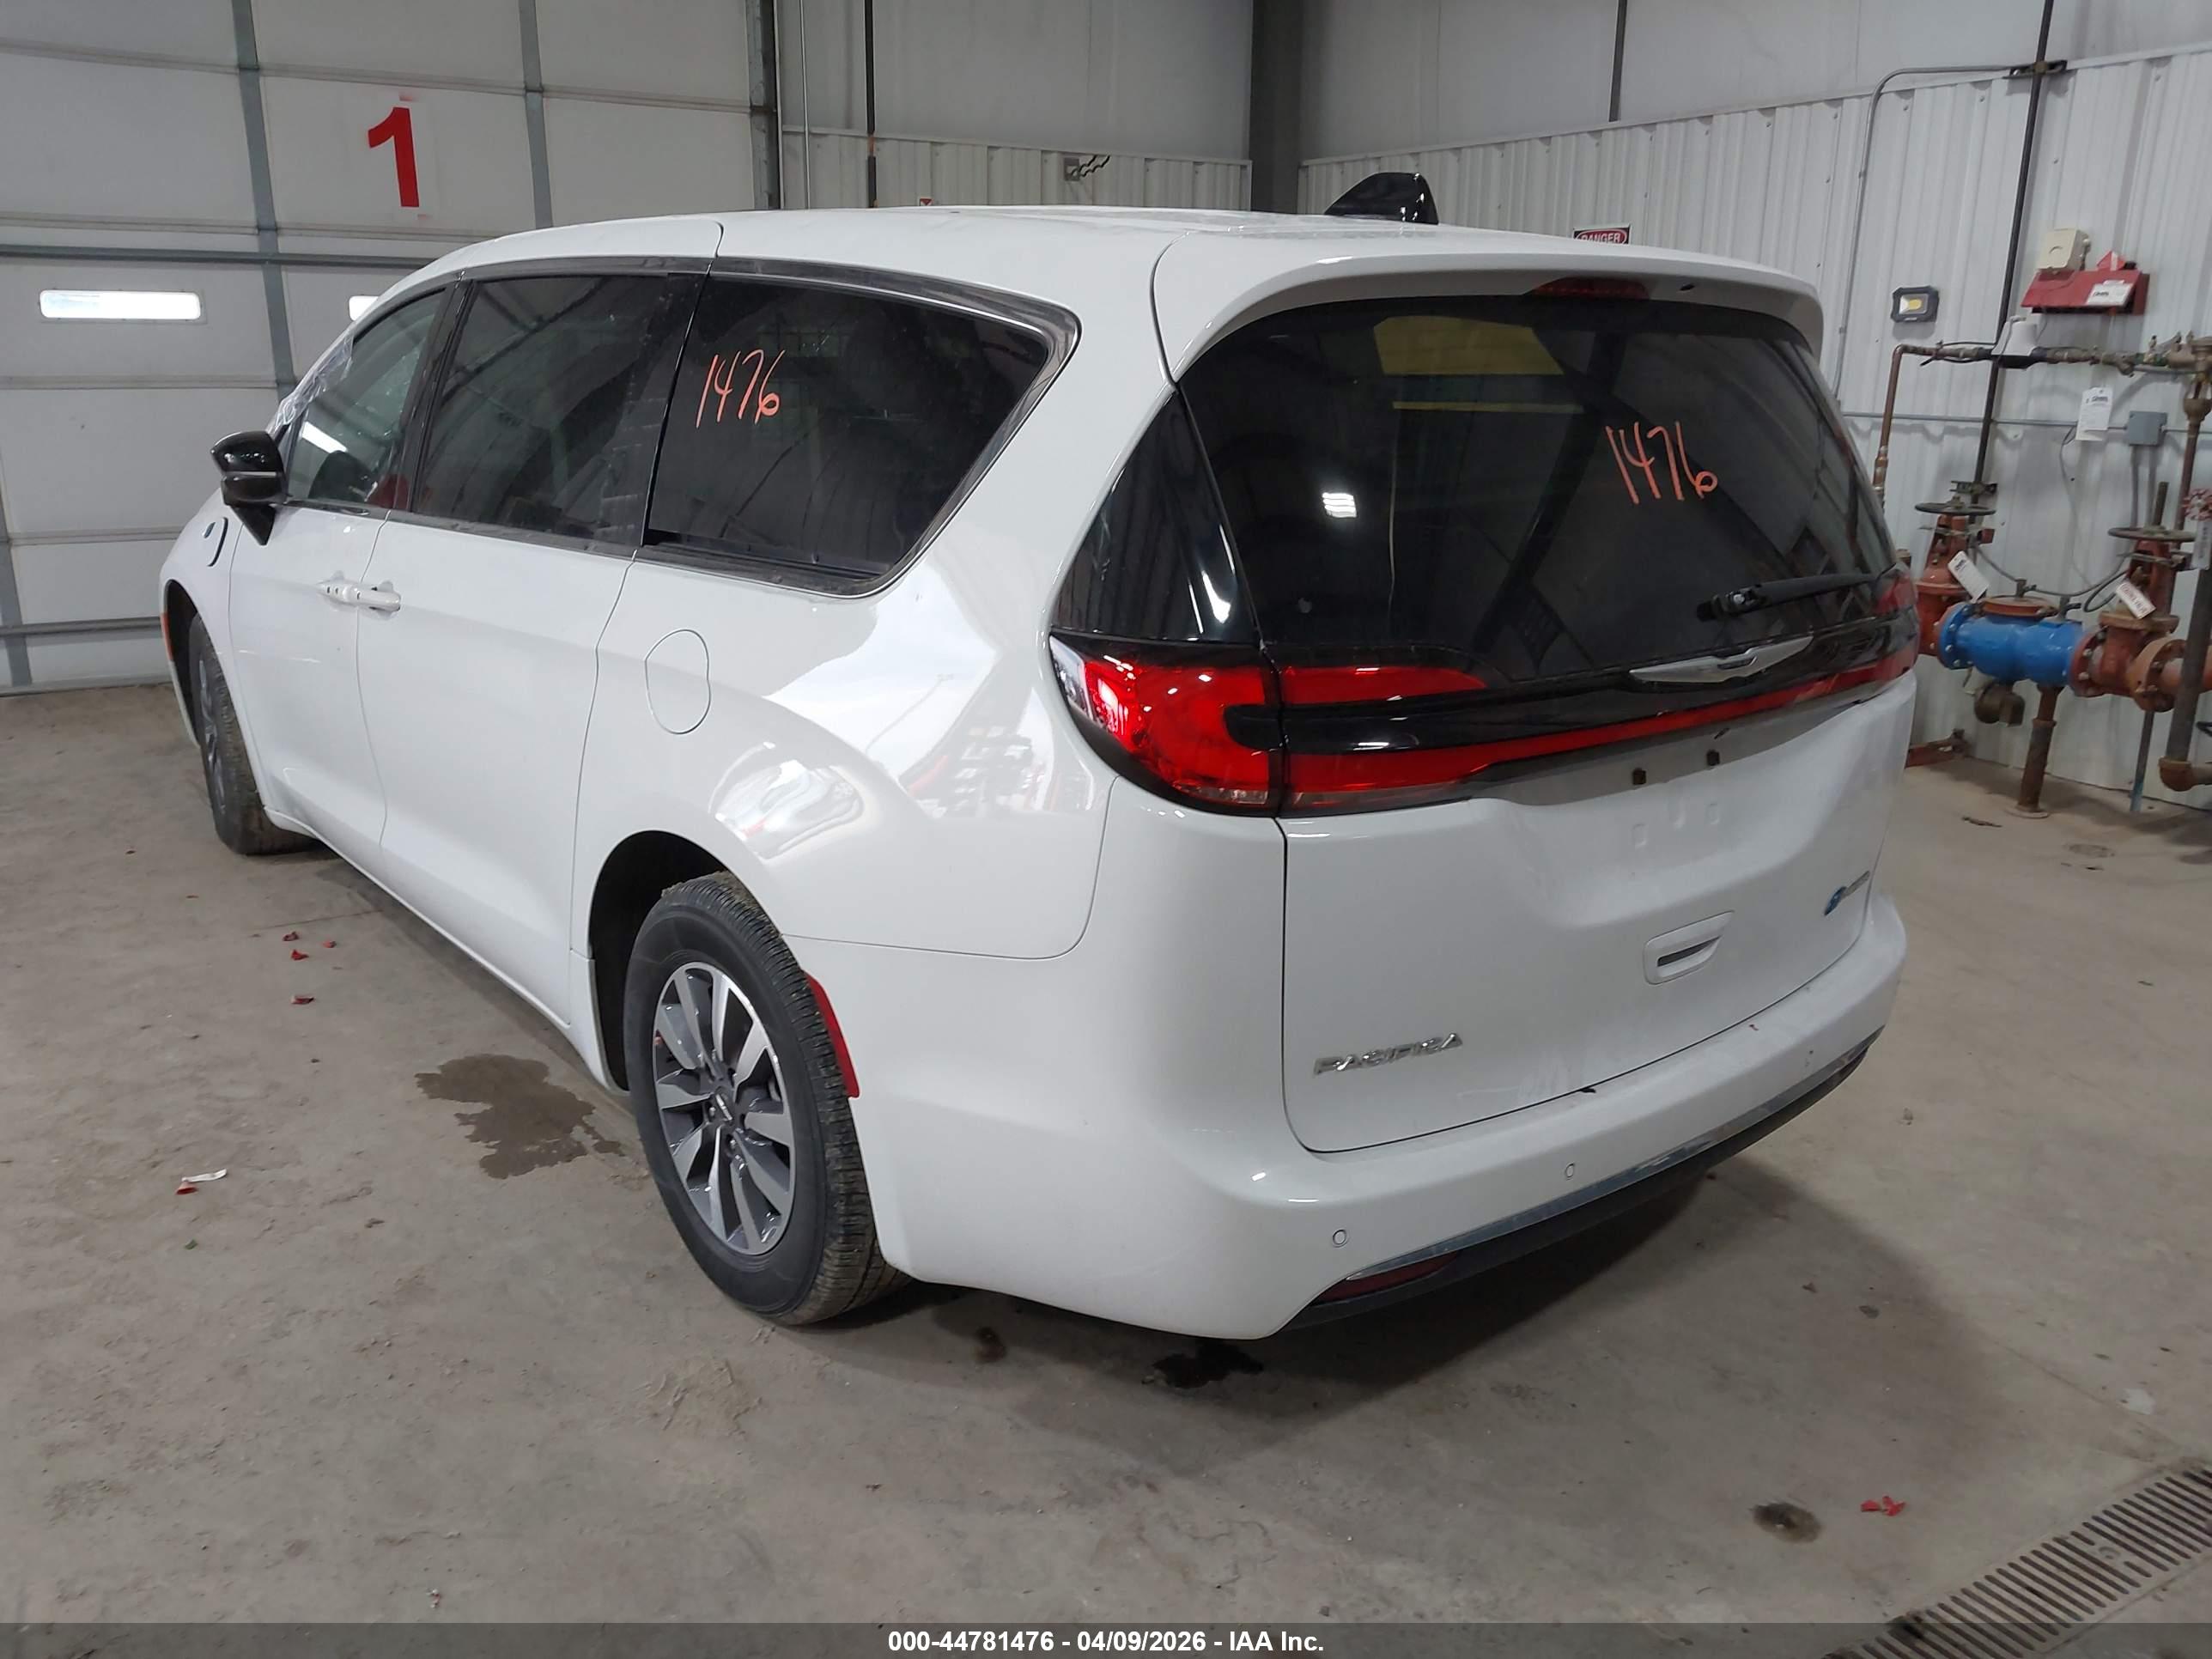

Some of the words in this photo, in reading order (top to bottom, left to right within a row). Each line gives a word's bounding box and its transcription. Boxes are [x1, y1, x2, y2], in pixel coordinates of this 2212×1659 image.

[368, 106, 420, 208] 1
[696, 349, 786, 428] 1476
[1605, 421, 1718, 505] 1476
[1314, 1032, 1463, 1075] PACIFICA
